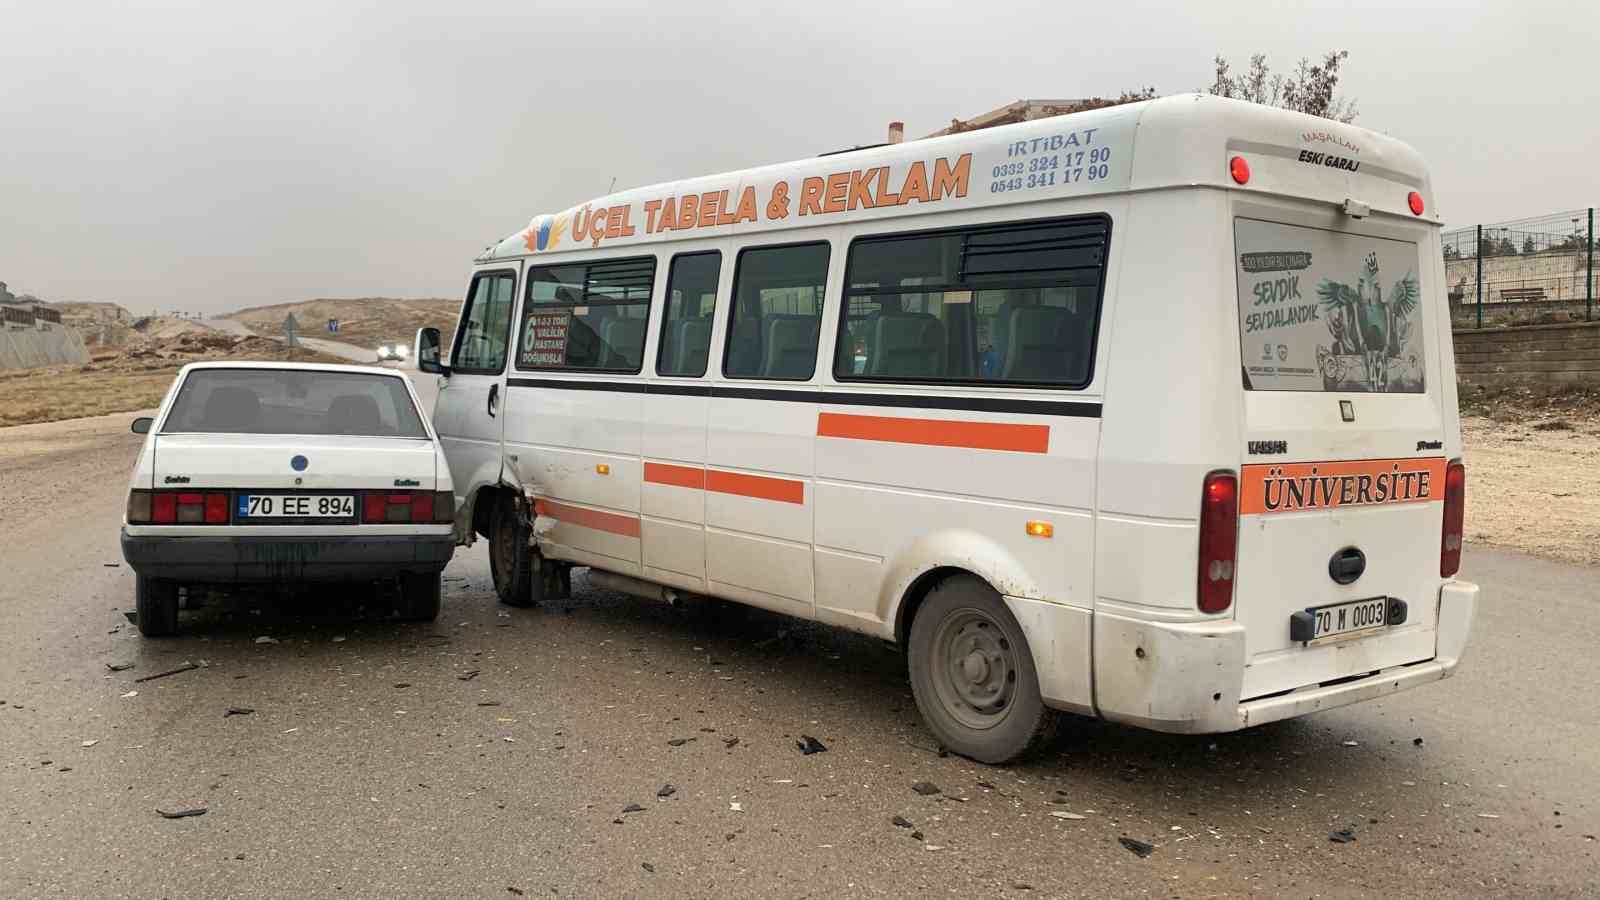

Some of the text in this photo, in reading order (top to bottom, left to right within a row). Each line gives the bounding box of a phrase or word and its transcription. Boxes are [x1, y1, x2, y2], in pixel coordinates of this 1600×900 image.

[992, 147, 1110, 178] 0332 324 17 90
[1325, 155, 1361, 172] GARAJ
[991, 164, 1109, 193] 0543 341 17 90
[572, 153, 973, 249] ÜÇEL TABELA & REKLAM
[1253, 271, 1302, 306] SEVDİK
[524, 316, 536, 352] 6
[1246, 304, 1320, 333] SEVDALANDIK
[1264, 463, 1430, 510] ÜNİVERSİTE
[249, 497, 352, 515] 70 EE 894
[1315, 603, 1383, 635] 70 M 0003
